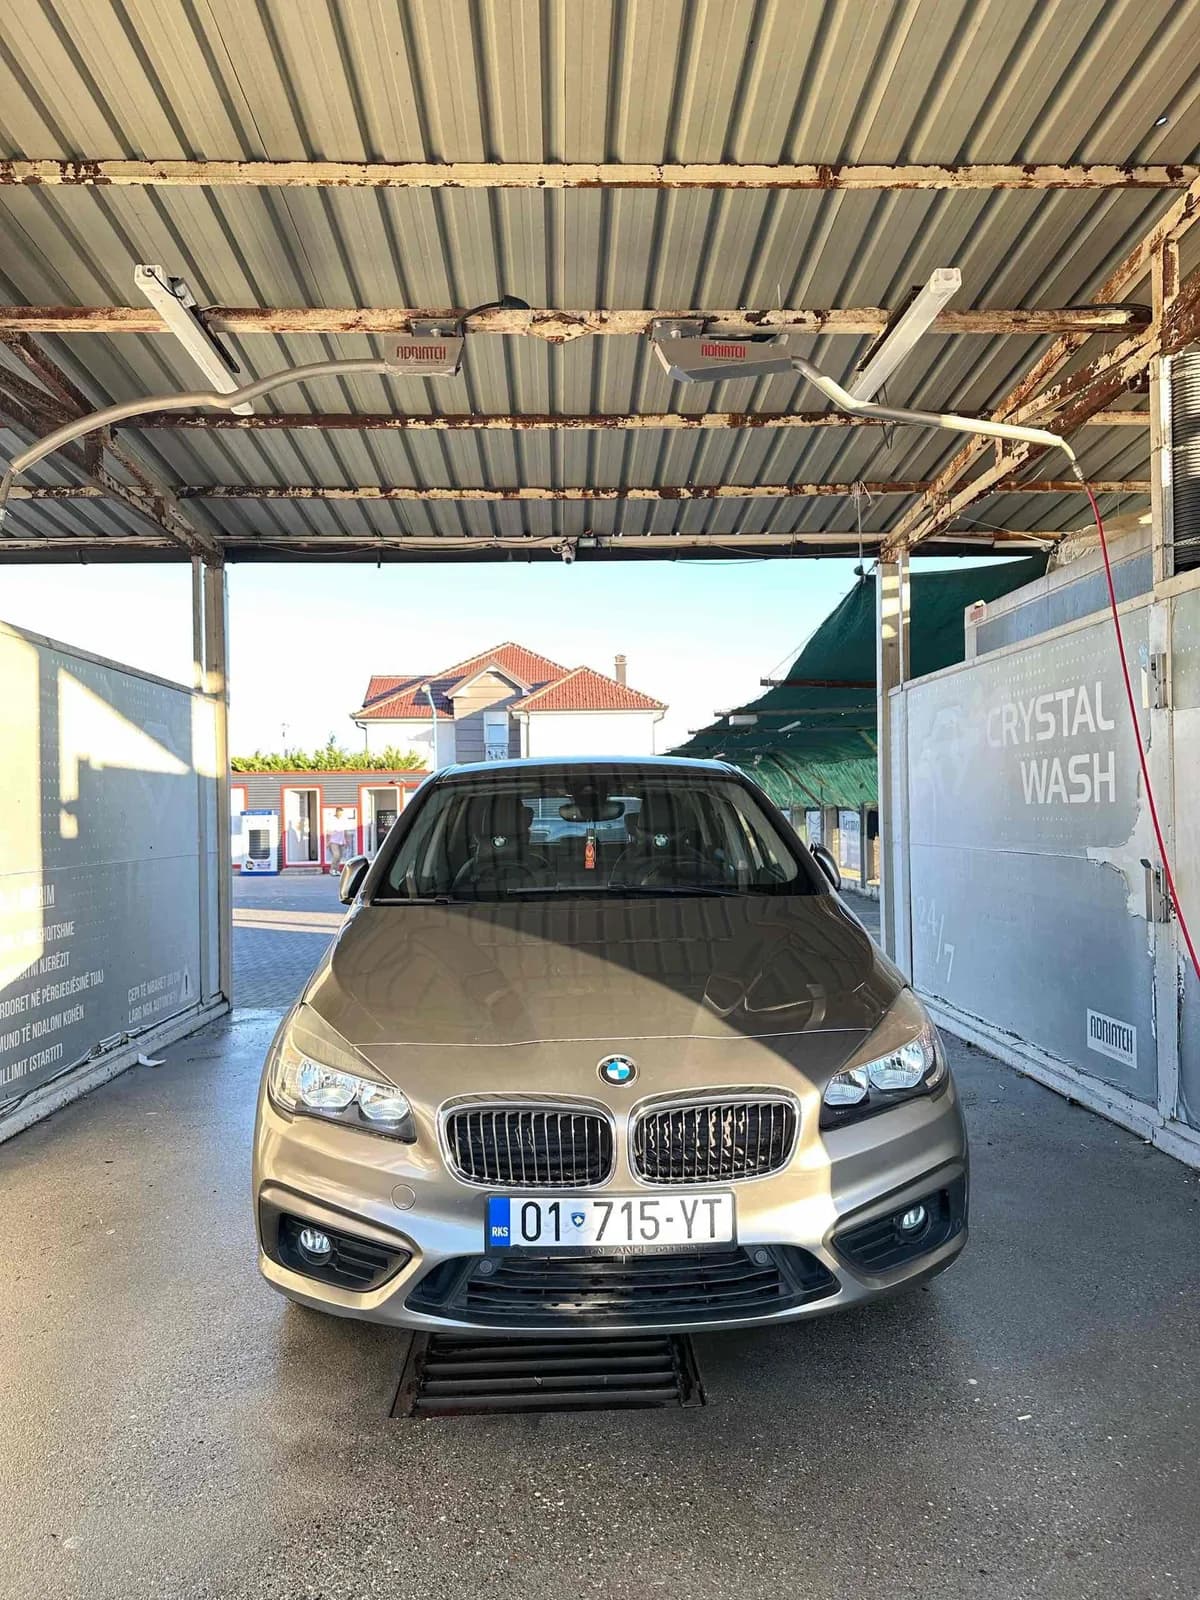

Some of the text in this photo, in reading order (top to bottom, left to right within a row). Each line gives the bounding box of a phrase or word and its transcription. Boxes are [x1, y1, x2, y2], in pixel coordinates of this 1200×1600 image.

[986, 681, 1115, 747] CRYSTAL
[1020, 751, 1116, 804] WASH
[31, 988, 41, 1009] NË
[21, 1022, 31, 1044] TË
[32, 1013, 62, 1039] NDALONI
[491, 1199, 722, 1242] RKS 01 715-YT
